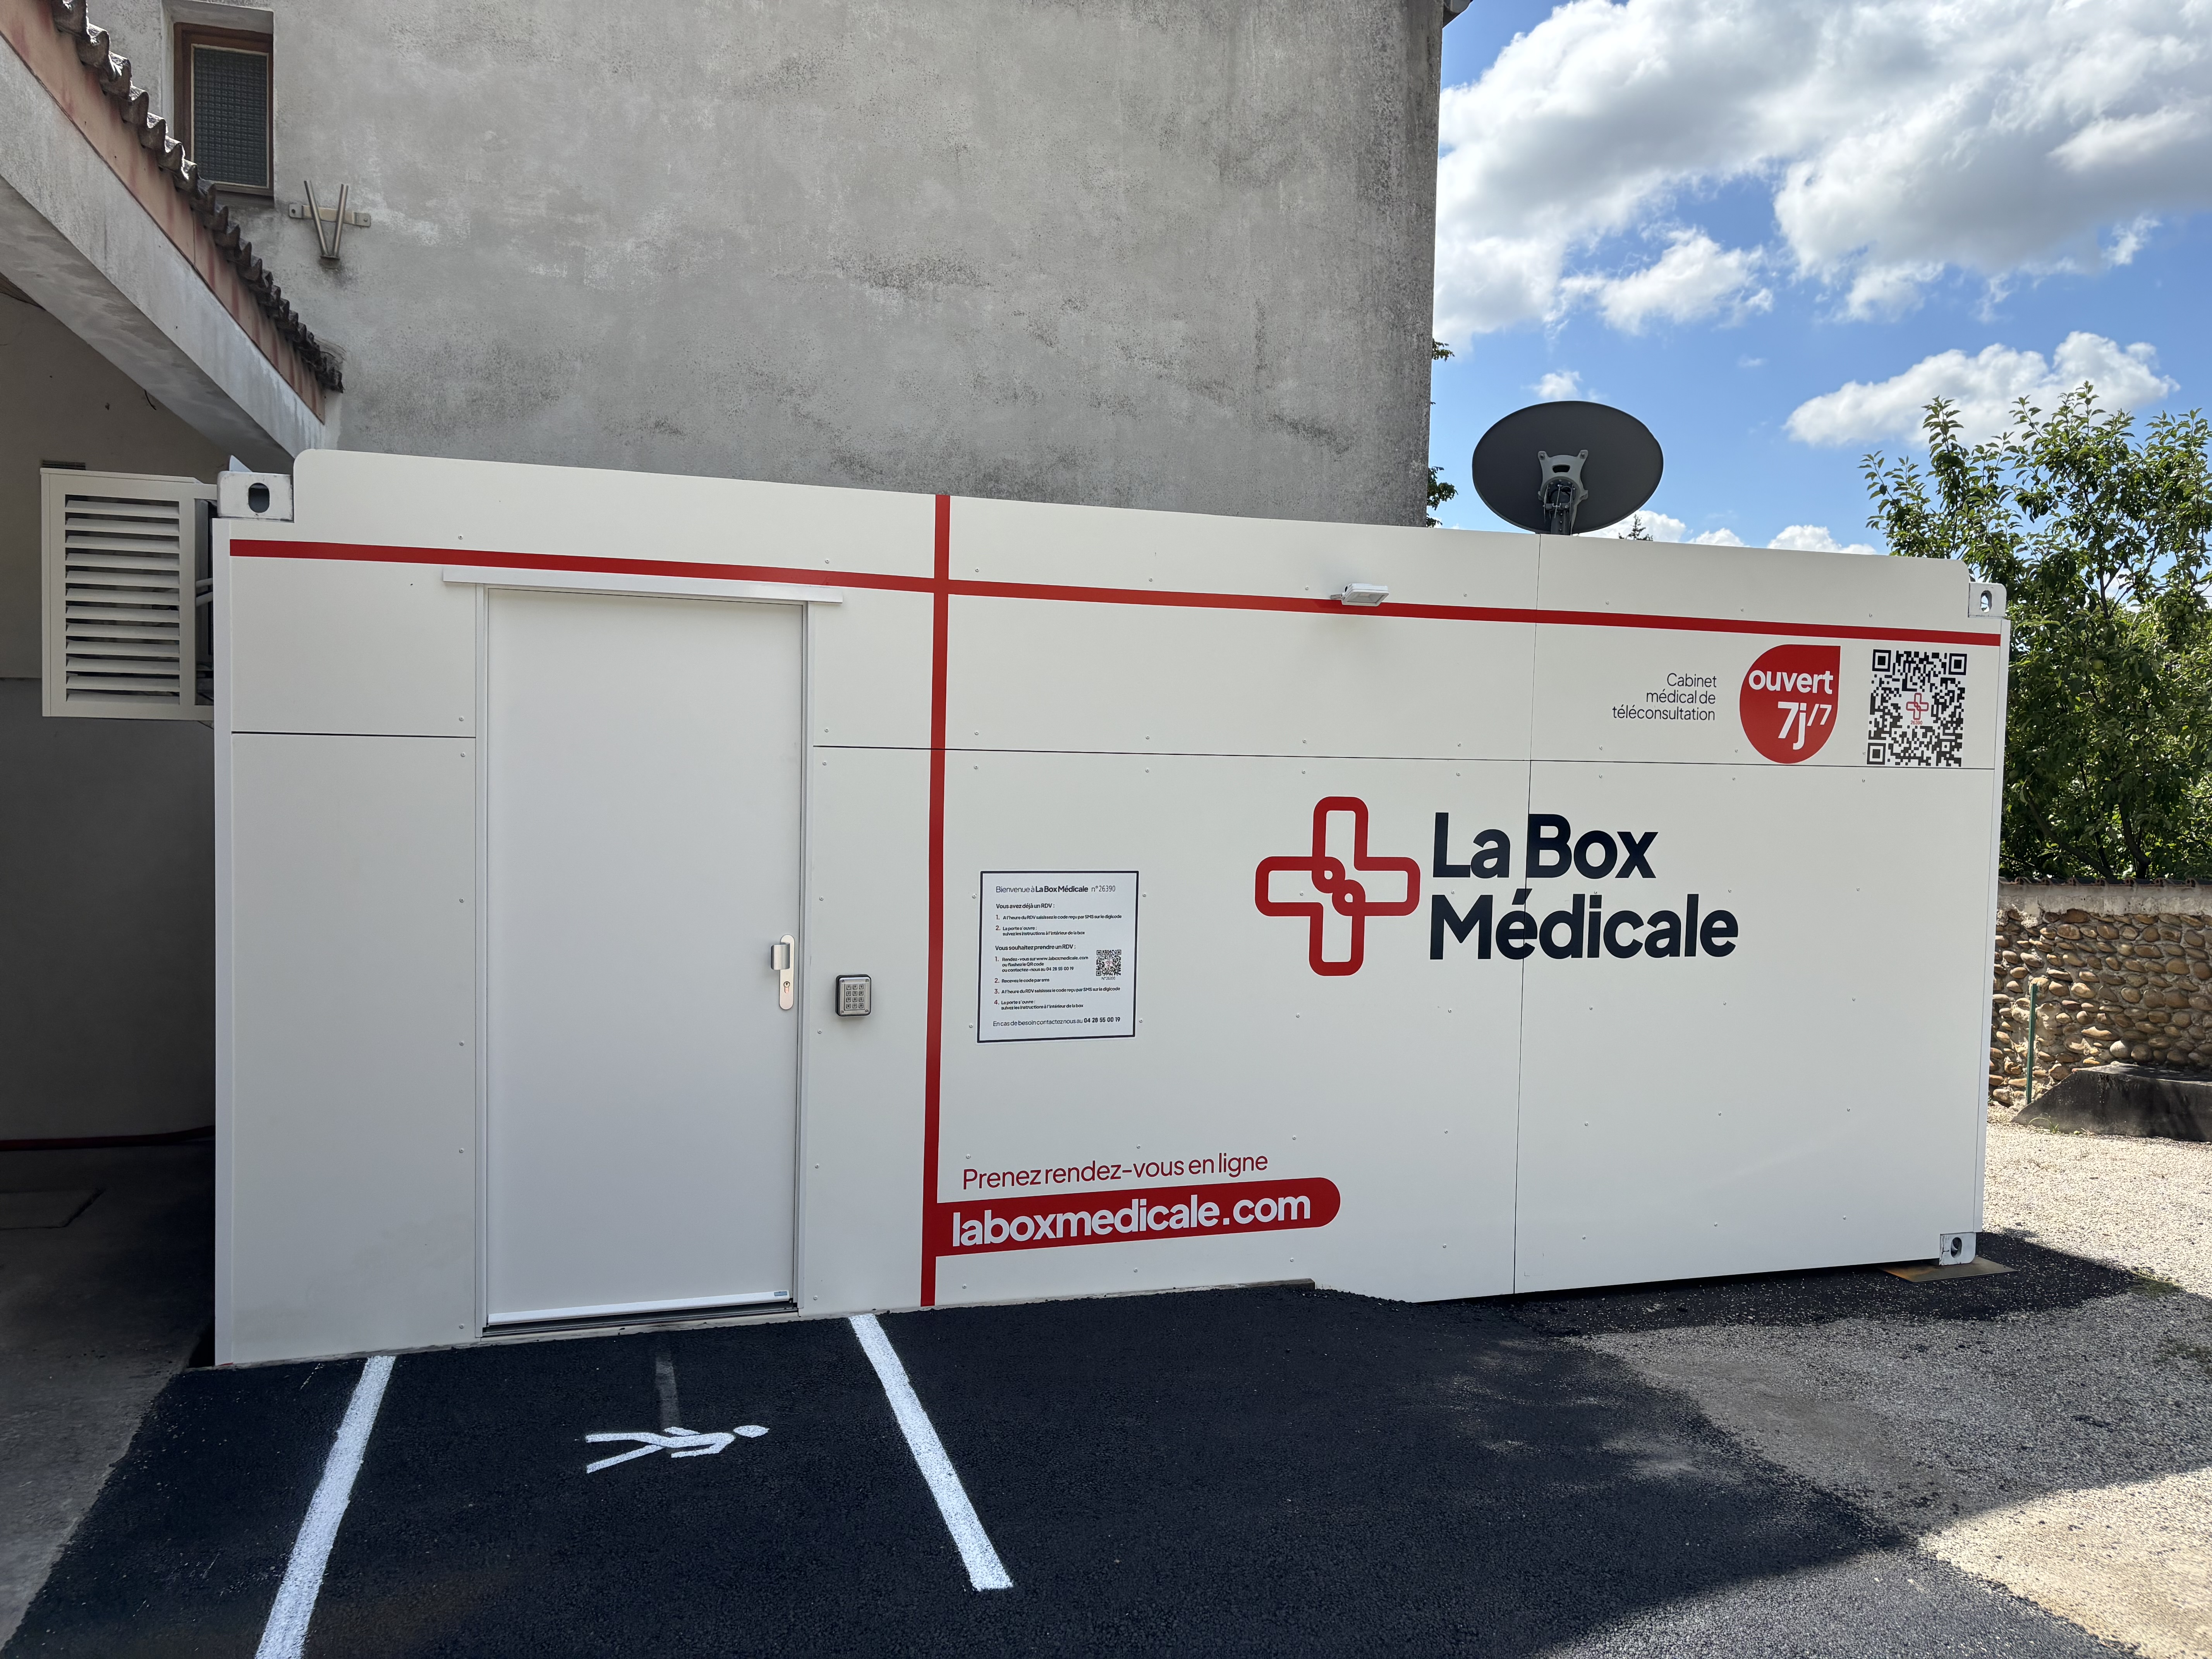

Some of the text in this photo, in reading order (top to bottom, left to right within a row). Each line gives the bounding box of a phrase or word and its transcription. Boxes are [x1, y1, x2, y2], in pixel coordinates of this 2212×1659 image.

[1667, 673, 1717, 688] Cabinet
[1749, 670, 1833, 694] ouvert
[1647, 689, 1716, 704] médical de
[1613, 705, 1715, 721] téléconsultation
[1432, 812, 1658, 879] La Box
[1430, 888, 1739, 960] Médicale
[963, 1152, 1268, 1190] Prenez rendez-vous en ligne
[952, 1194, 1311, 1248] laboxmedicale.com
